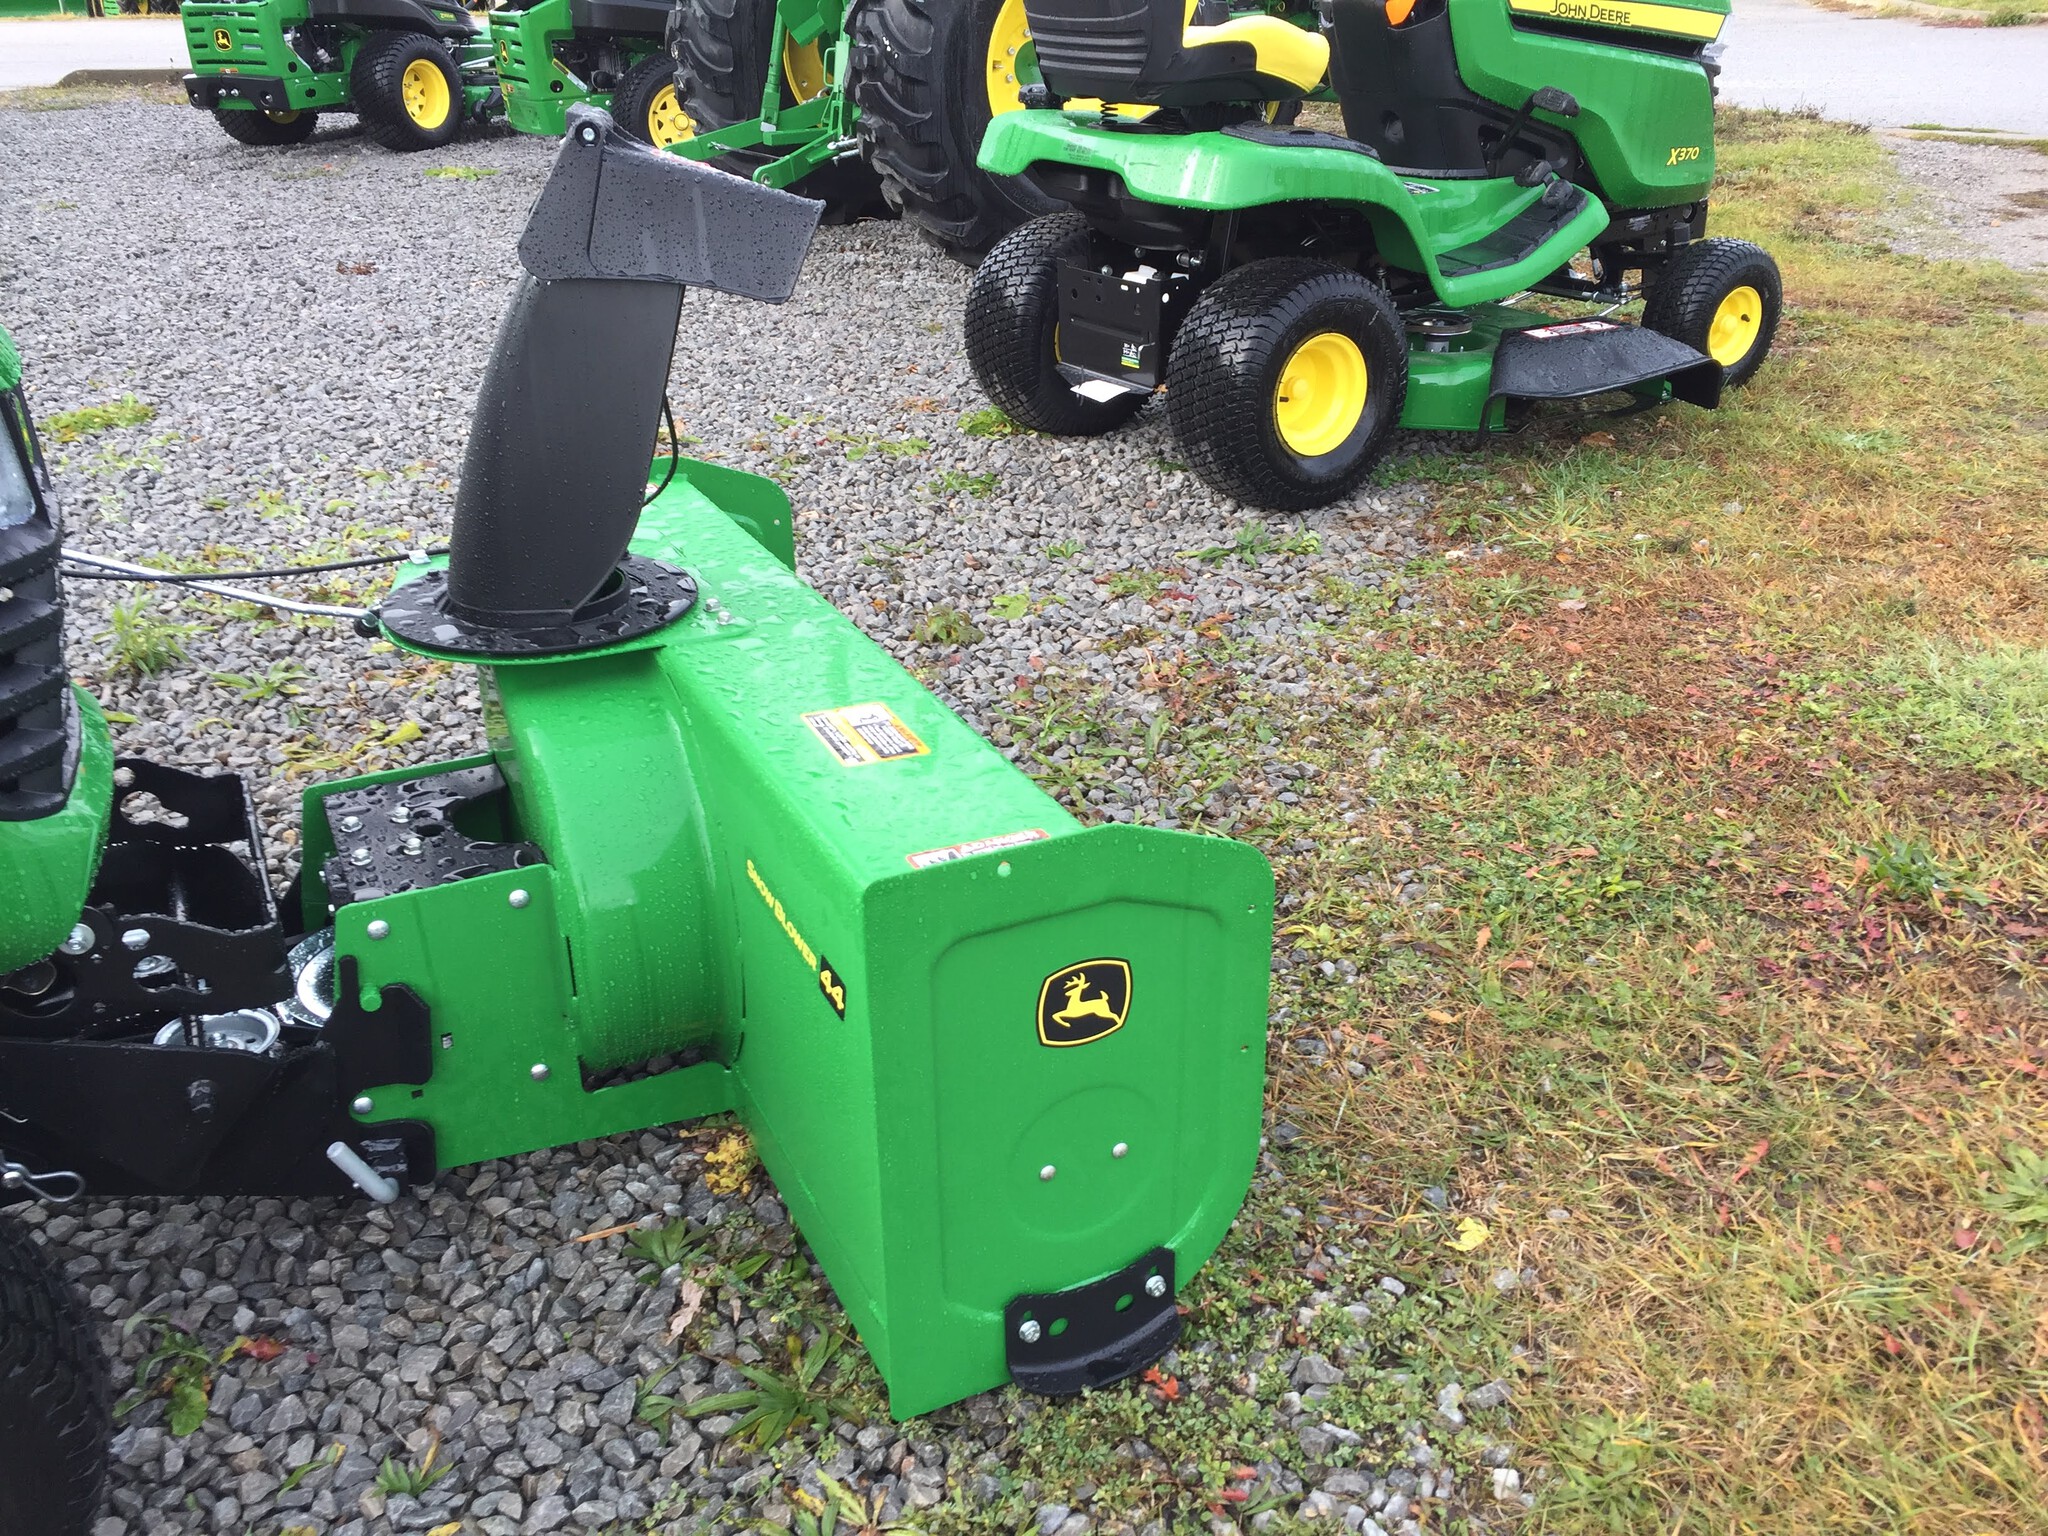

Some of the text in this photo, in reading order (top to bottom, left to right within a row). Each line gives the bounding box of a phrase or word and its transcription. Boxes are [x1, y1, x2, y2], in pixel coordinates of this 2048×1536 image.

[1550, 0, 1631, 24] JOHN DEERE
[1666, 146, 1699, 166] X370
[820, 970, 844, 1010] 44
